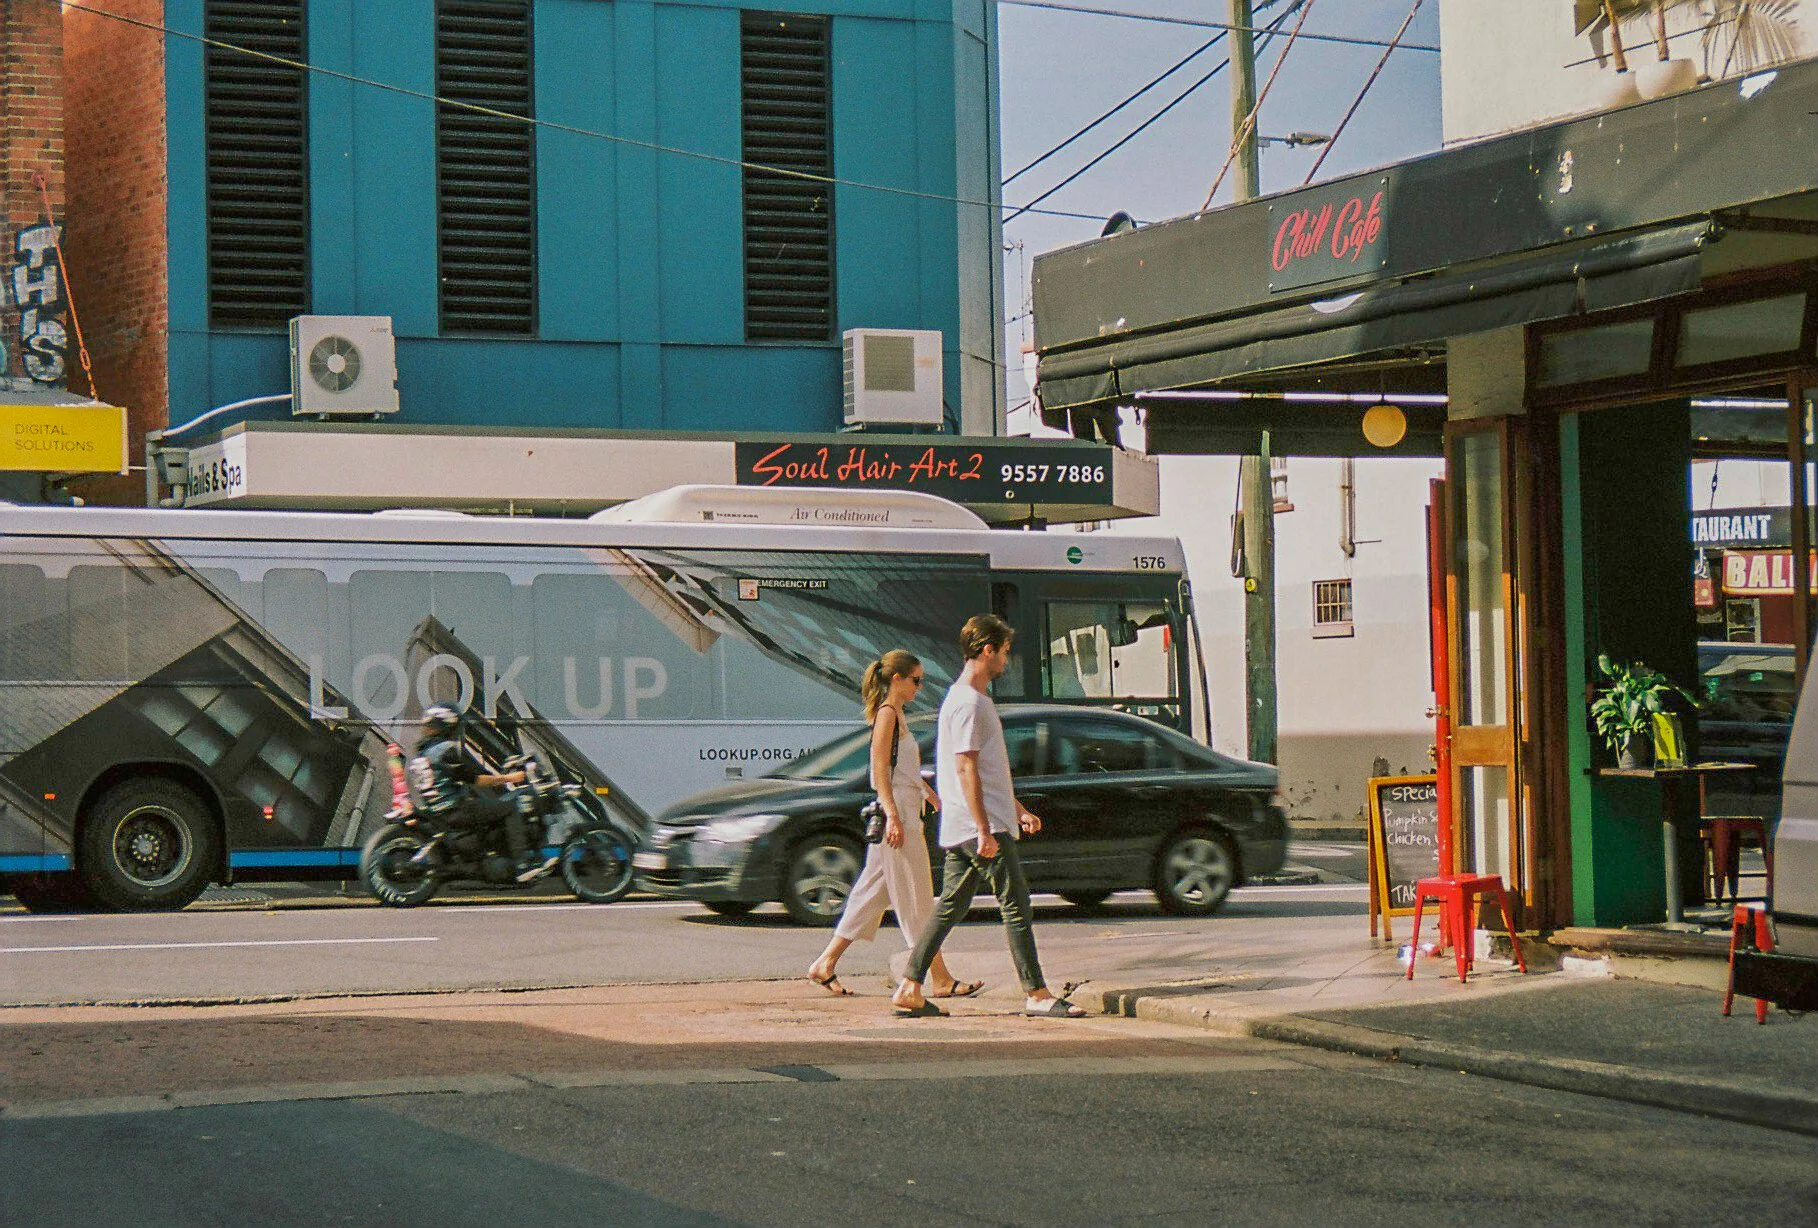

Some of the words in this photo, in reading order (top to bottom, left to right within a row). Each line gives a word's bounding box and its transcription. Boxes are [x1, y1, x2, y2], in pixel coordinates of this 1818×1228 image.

[1271, 203, 1333, 272] Chill
[14, 423, 68, 435] DIGITAL
[14, 439, 95, 452] SOLUTIONS
[752, 443, 829, 486] Soul
[837, 447, 903, 482] Hair
[908, 447, 958, 483] Art
[958, 453, 983, 480] 2
[1000, 464, 1050, 483] 9557
[1056, 464, 1105, 484] 7886
[221, 457, 241, 495] Spa
[790, 507, 809, 520] Air
[814, 508, 890, 523] Conditioned
[1693, 515, 1771, 541] TAURANT
[1132, 556, 1166, 569] 1576
[758, 580, 808, 588] EMERGENCY
[809, 580, 827, 588] EXIT
[309, 653, 534, 721] LOOK
[563, 655, 668, 720] UP
[1391, 881, 1417, 903] TAK
